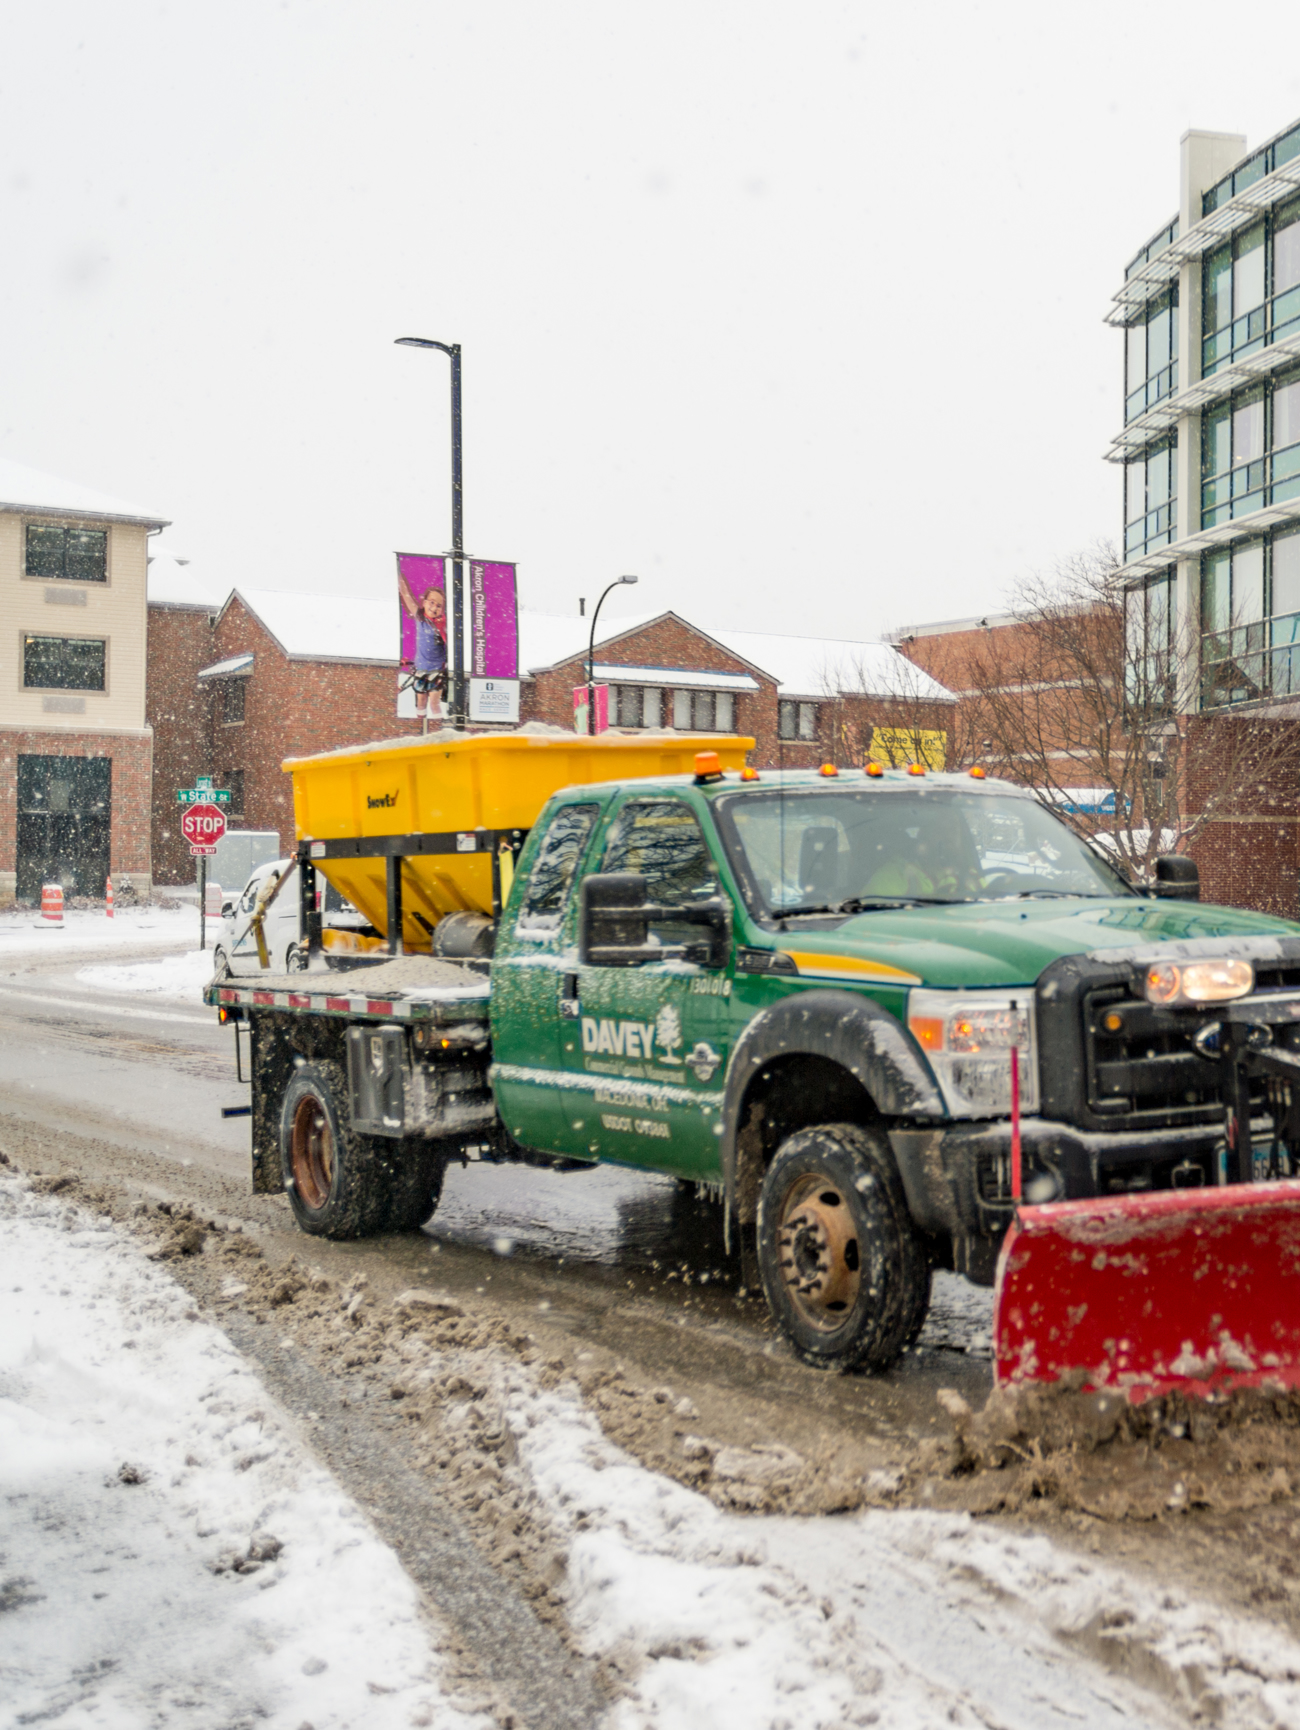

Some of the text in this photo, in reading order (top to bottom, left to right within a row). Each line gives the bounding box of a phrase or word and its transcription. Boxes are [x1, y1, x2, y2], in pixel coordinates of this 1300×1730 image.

[474, 565, 486, 675] Akron Children's Hospital
[480, 693, 510, 701] AKRON
[180, 792, 187, 801] W
[189, 791, 217, 801] State
[185, 816, 223, 833] STOP
[581, 1017, 655, 1059] DAVEY
